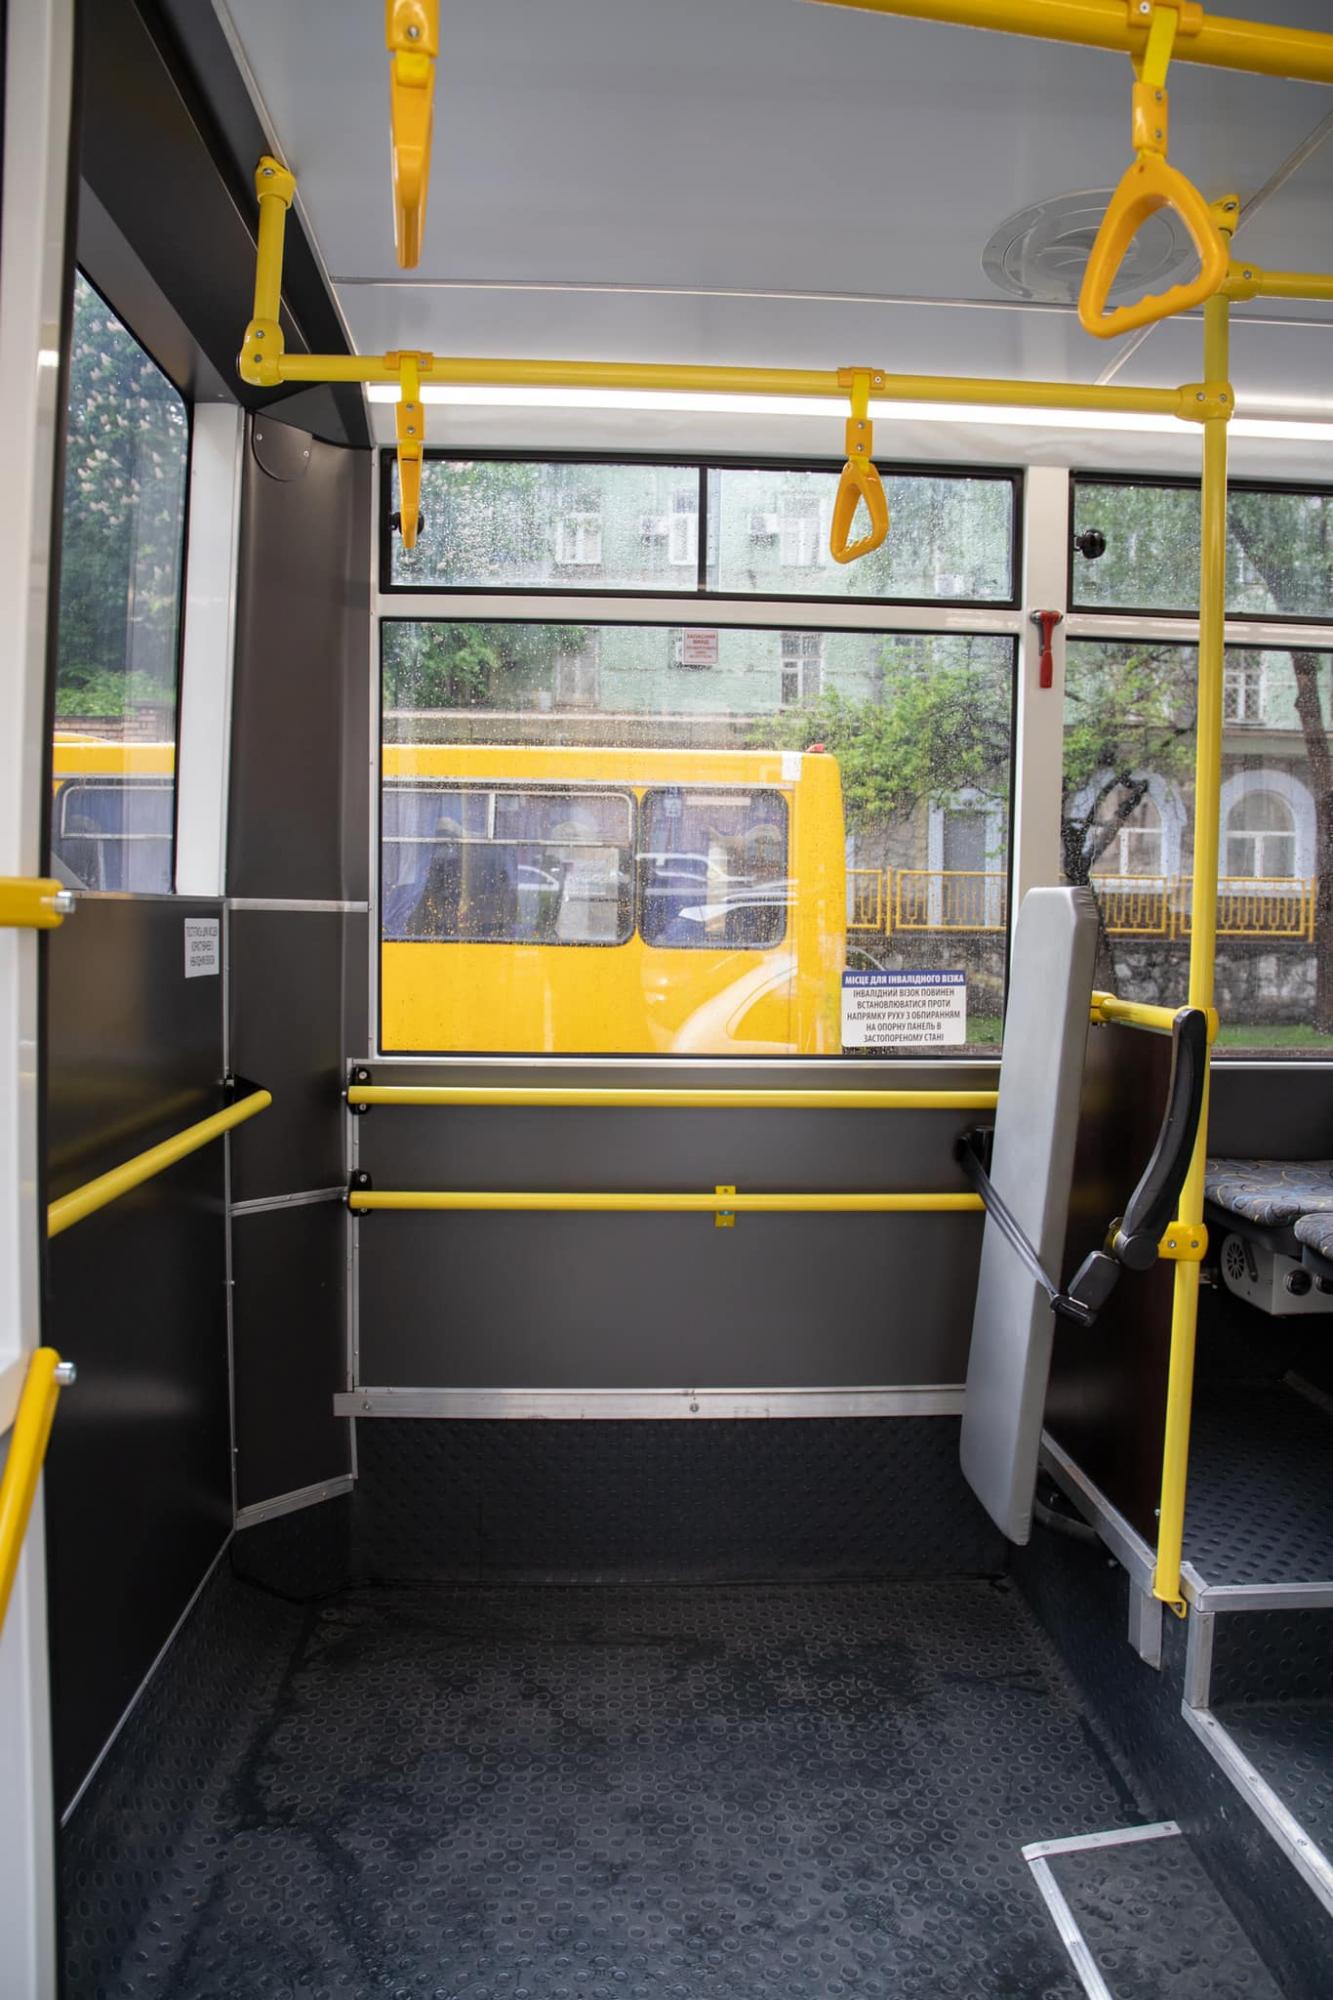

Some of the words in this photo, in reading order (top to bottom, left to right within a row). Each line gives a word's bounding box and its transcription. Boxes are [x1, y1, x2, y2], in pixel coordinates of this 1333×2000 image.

[845, 976, 869, 985] МІСЦЕ
[870, 975, 887, 985] ДЛЯ
[888, 974, 941, 985] ІНВАЛІДНОГО
[942, 974, 964, 983] ВІЗКА
[853, 988, 898, 998] ІНВАЛІДНИЙ
[899, 988, 920, 997] ВІЗОК
[921, 988, 955, 997] ПОВИНЕН
[857, 999, 926, 1009] ВСТАНОВЛЮВАТИСЯ
[927, 999, 951, 1008] ПРОТИ
[847, 1011, 886, 1021] НАПРЯМКУ
[887, 1011, 905, 1020] РУХУ
[905, 1011, 910, 1020] З
[911, 1010, 960, 1020] ОБПИРАННЯМ
[866, 1023, 876, 1031] НА
[877, 1022, 906, 1031] ОПОРНУ
[907, 1022, 936, 1030] ПАНЕЛЬ
[936, 1022, 942, 1031] В
[864, 1033, 923, 1043] ЗАСТОПОРЕНОМУ
[924, 1033, 945, 1041] СТАНІ
